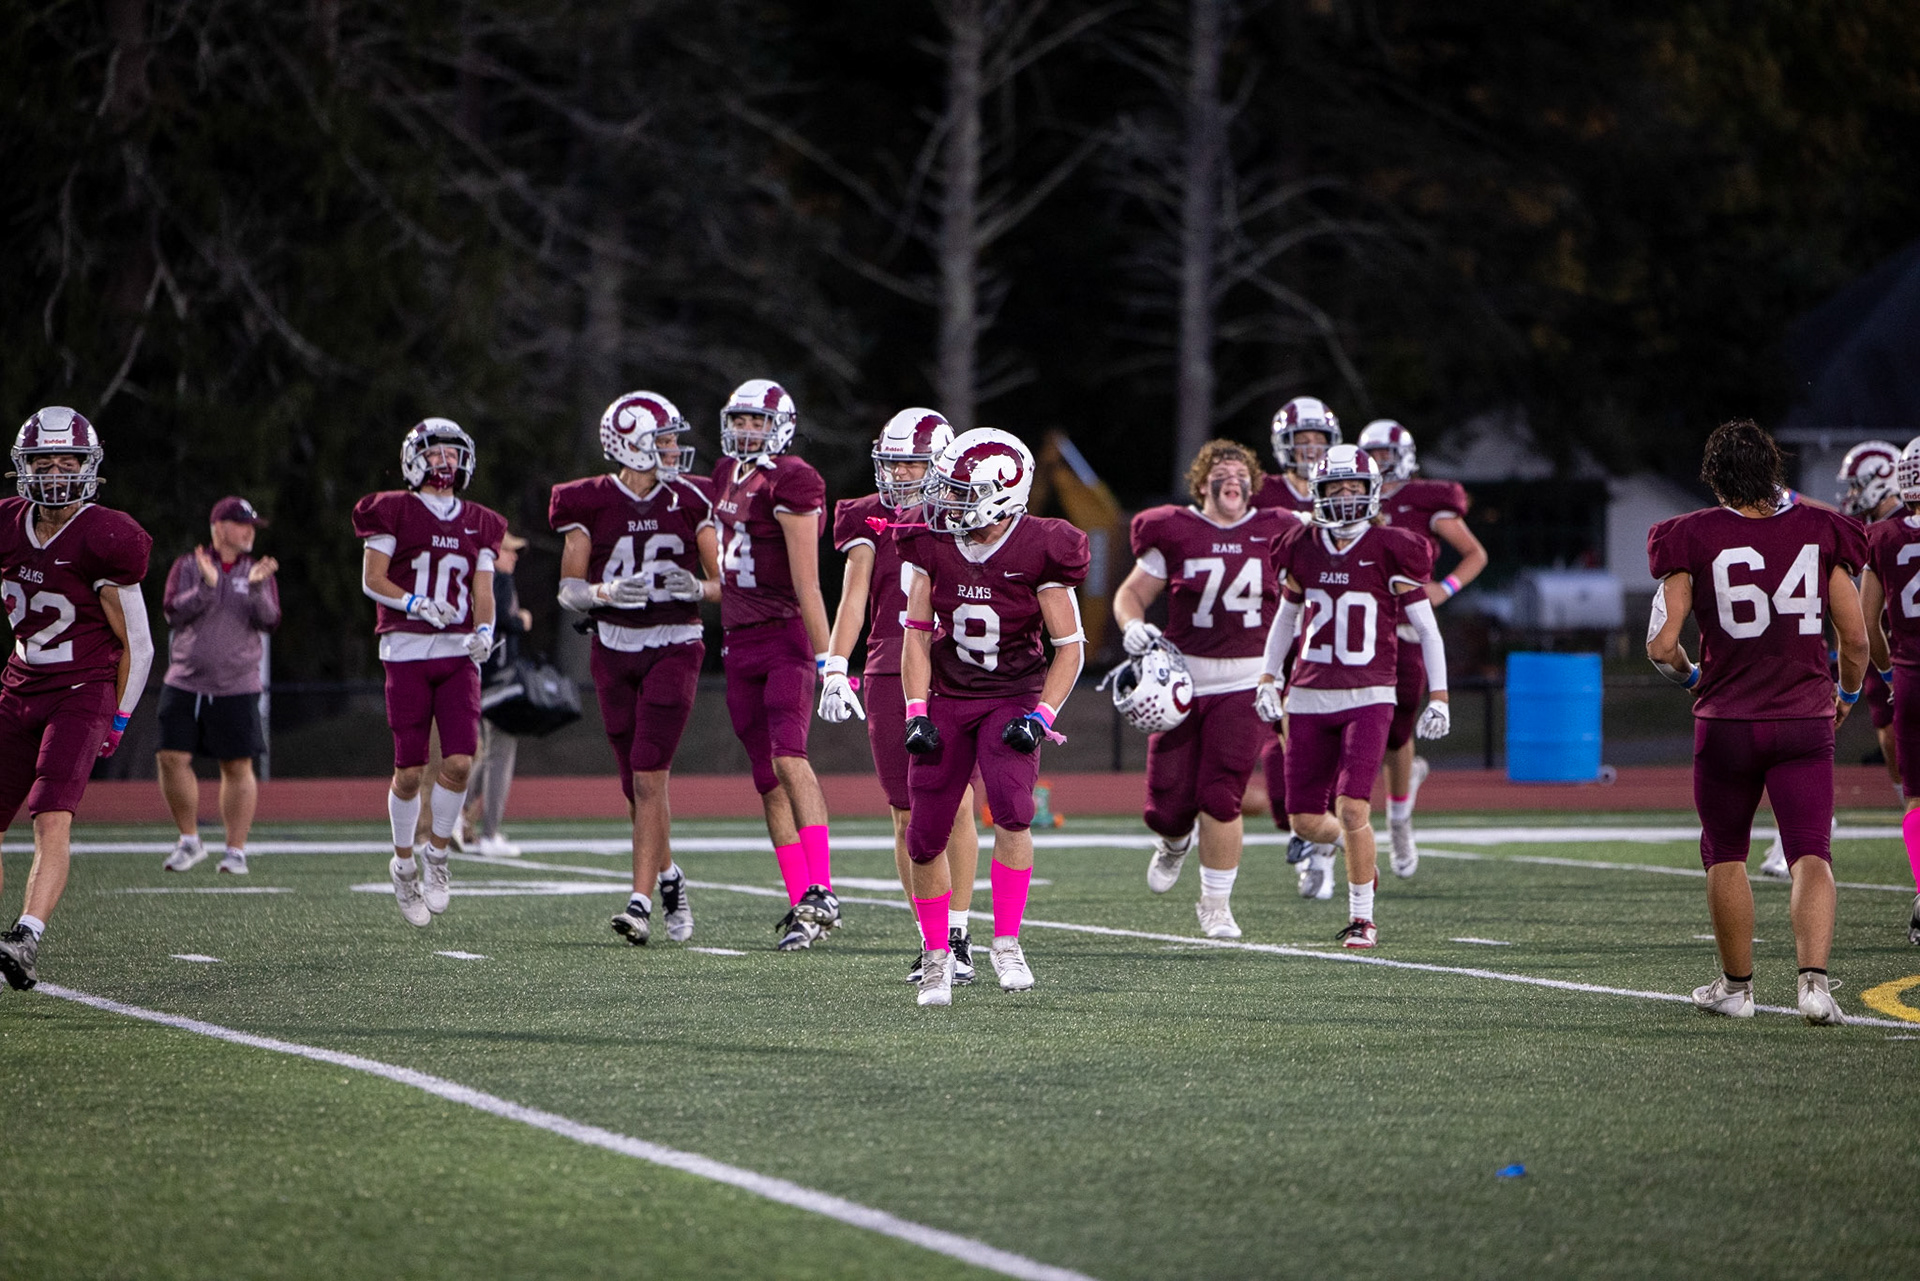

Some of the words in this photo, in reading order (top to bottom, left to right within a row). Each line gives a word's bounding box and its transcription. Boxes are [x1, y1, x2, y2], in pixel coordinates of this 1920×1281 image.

[627, 519, 659, 532] RAMS
[431, 535, 460, 550] RAMS
[1212, 543, 1243, 554] RAMS
[18, 565, 44, 584] RAMS
[602, 533, 684, 603] 46
[1319, 571, 1350, 585] RAMS
[406, 551, 470, 625] 10
[957, 584, 992, 599] RAMS
[1183, 557, 1264, 629] 74
[1711, 543, 1823, 640] 64
[1301, 588, 1378, 666] 20
